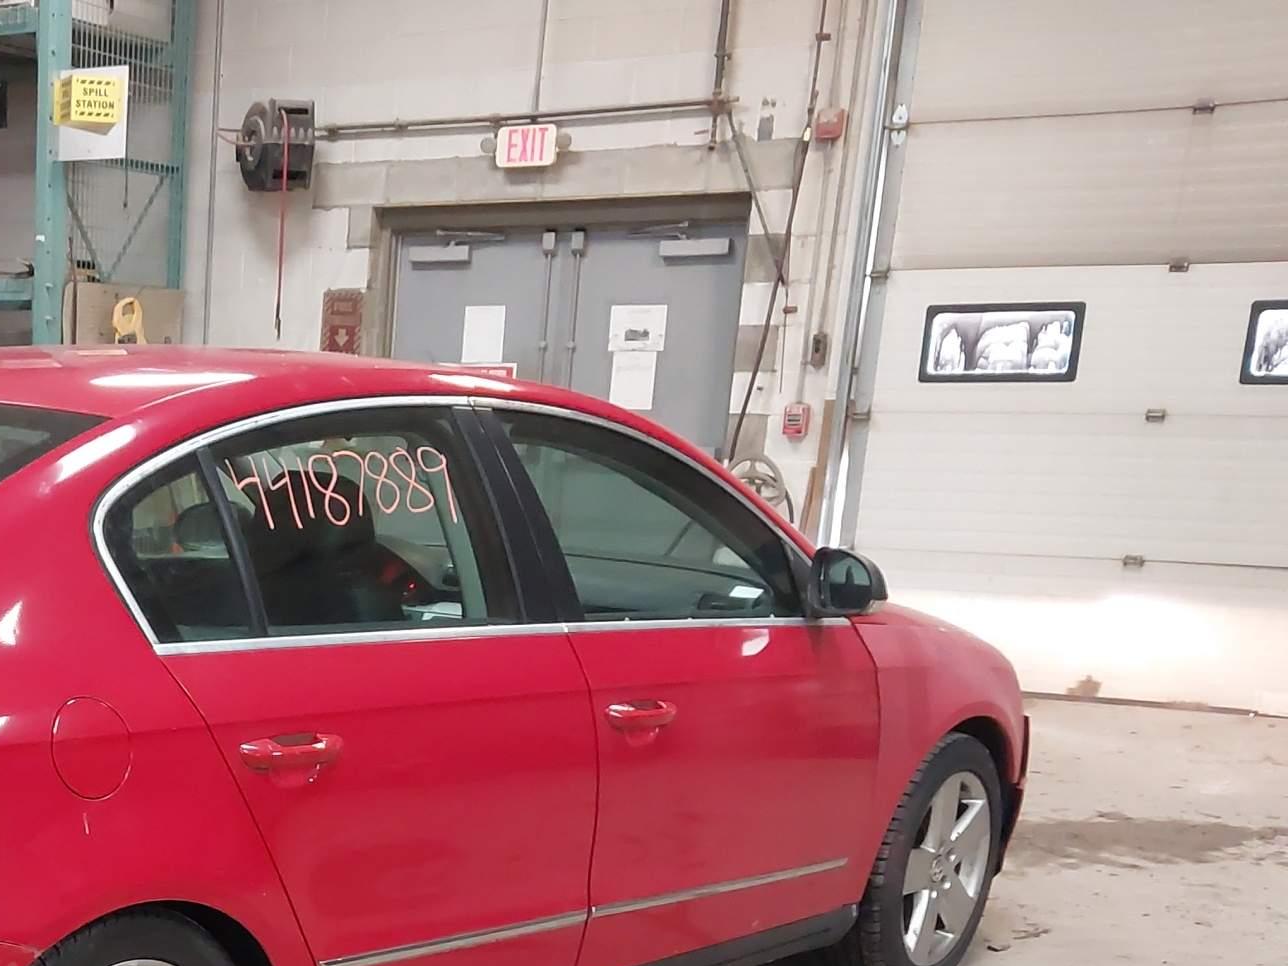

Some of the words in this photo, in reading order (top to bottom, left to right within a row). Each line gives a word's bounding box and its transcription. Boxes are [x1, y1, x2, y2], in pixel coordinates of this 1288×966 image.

[82, 87, 110, 97] SPILL
[75, 99, 115, 110] STATION
[506, 127, 549, 163] EXIT
[224, 446, 458, 530] 44187889
